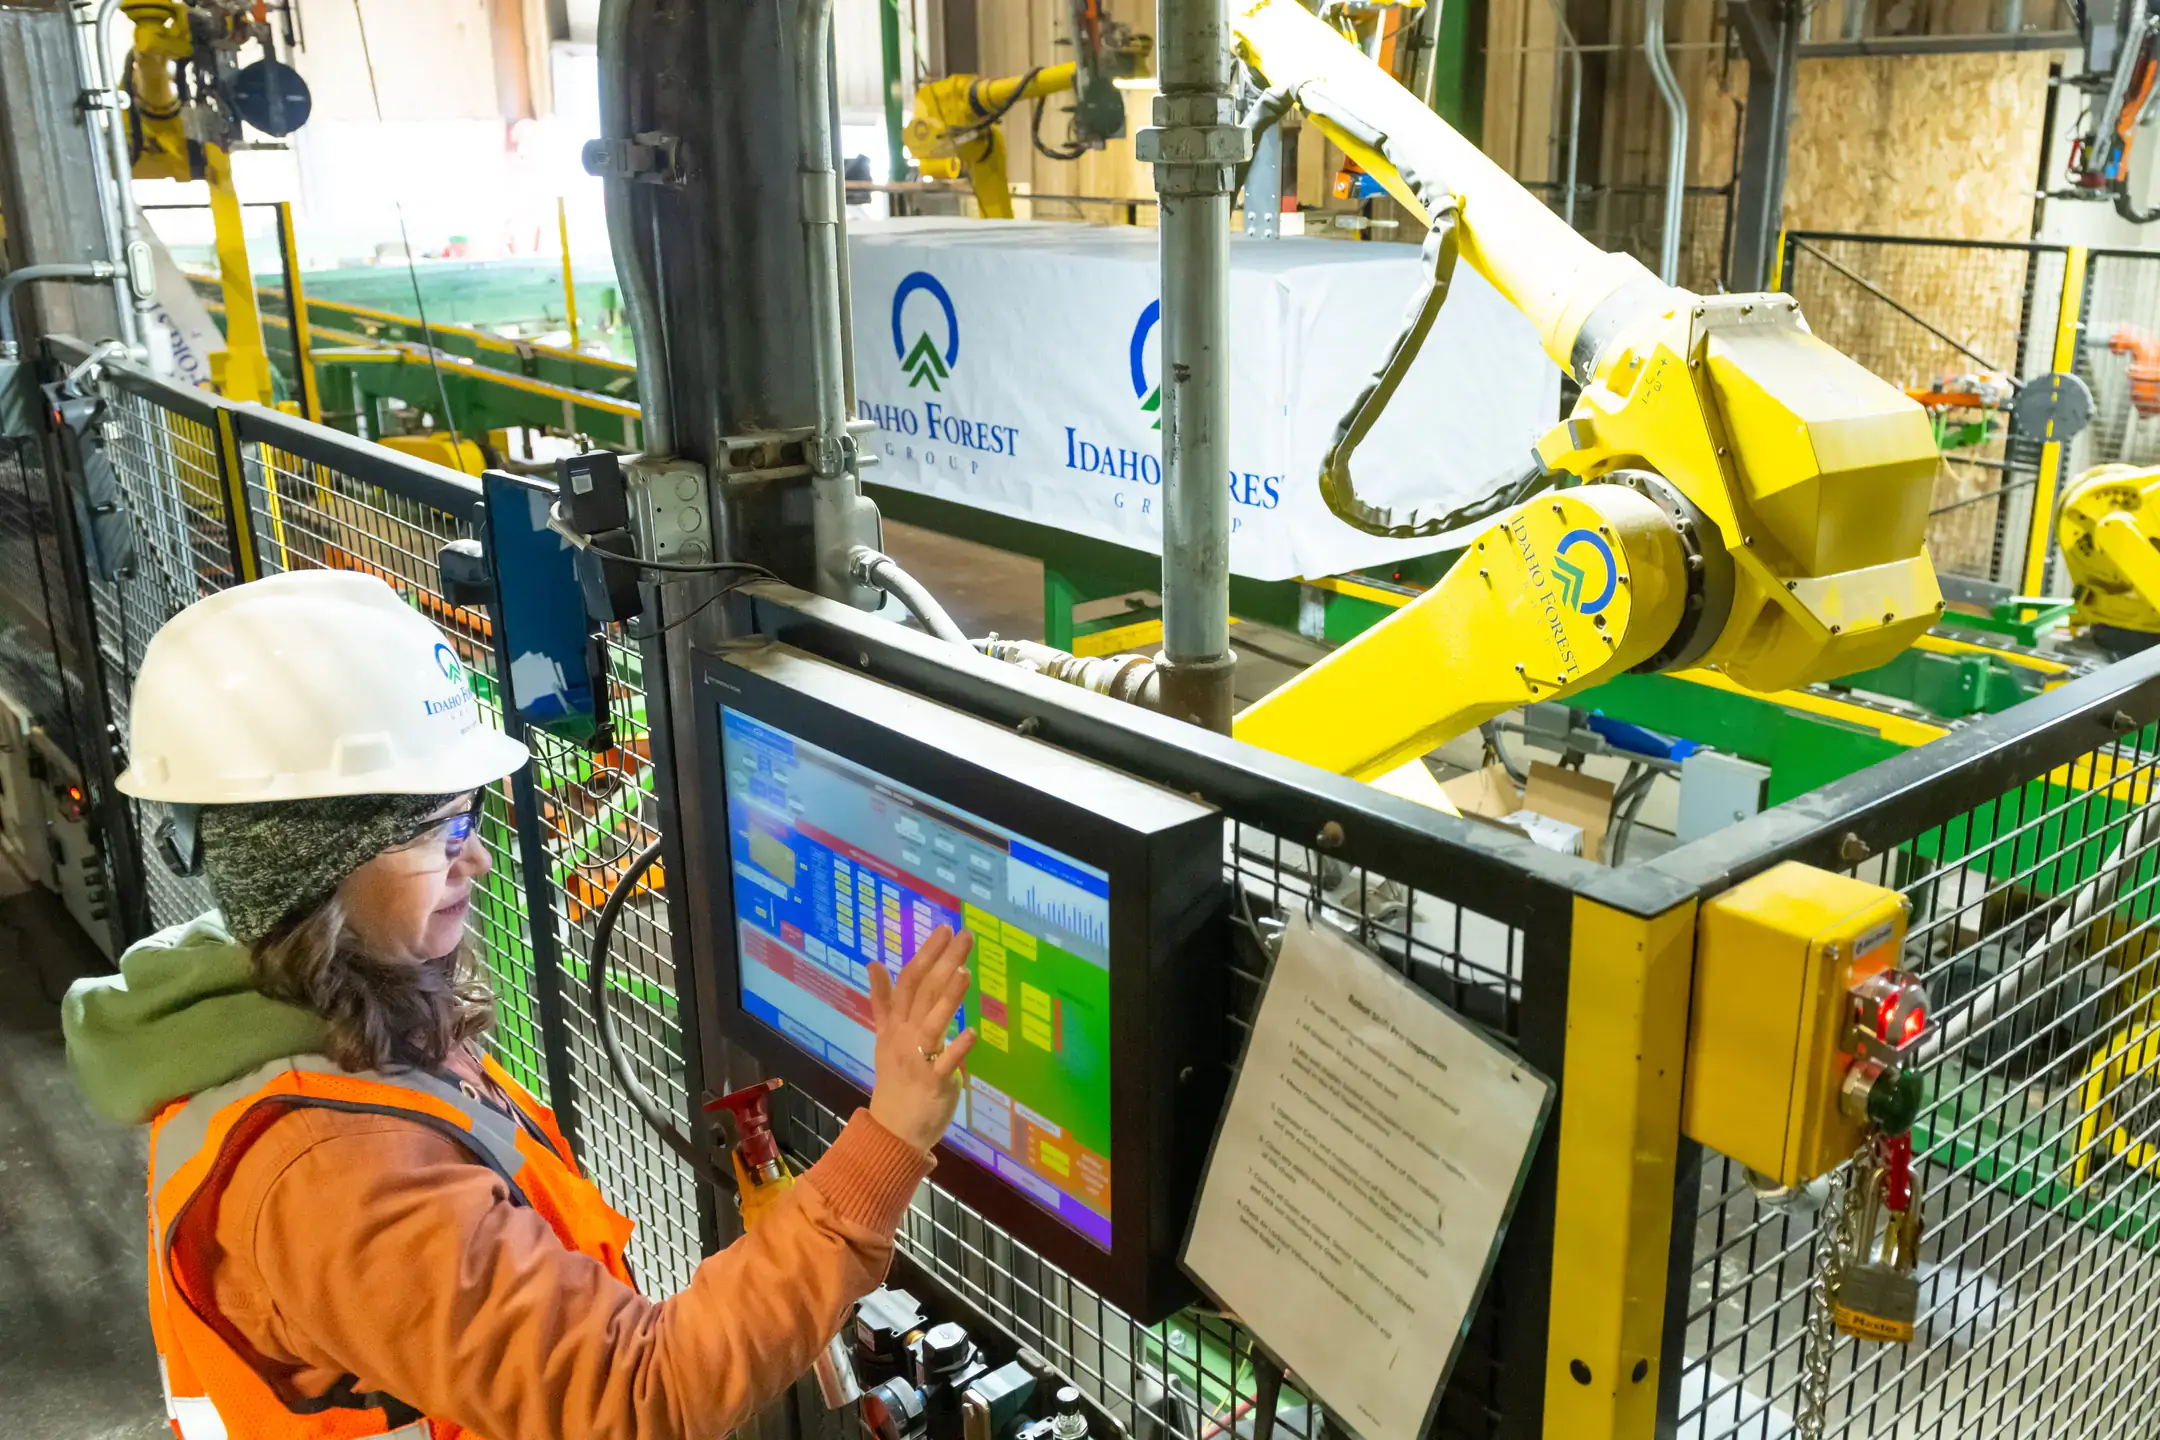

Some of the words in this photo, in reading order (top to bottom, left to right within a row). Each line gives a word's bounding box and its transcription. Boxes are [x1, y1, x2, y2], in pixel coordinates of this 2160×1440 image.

[857, 399, 918, 436] DAHO
[925, 401, 1019, 456] FOREST
[1065, 426, 1161, 485] IDAHO
[885, 442, 979, 474] GROUP
[1511, 515, 1545, 588] IDAHO
[1540, 591, 1580, 675] FOREST
[422, 694, 462, 716] IDAHO
